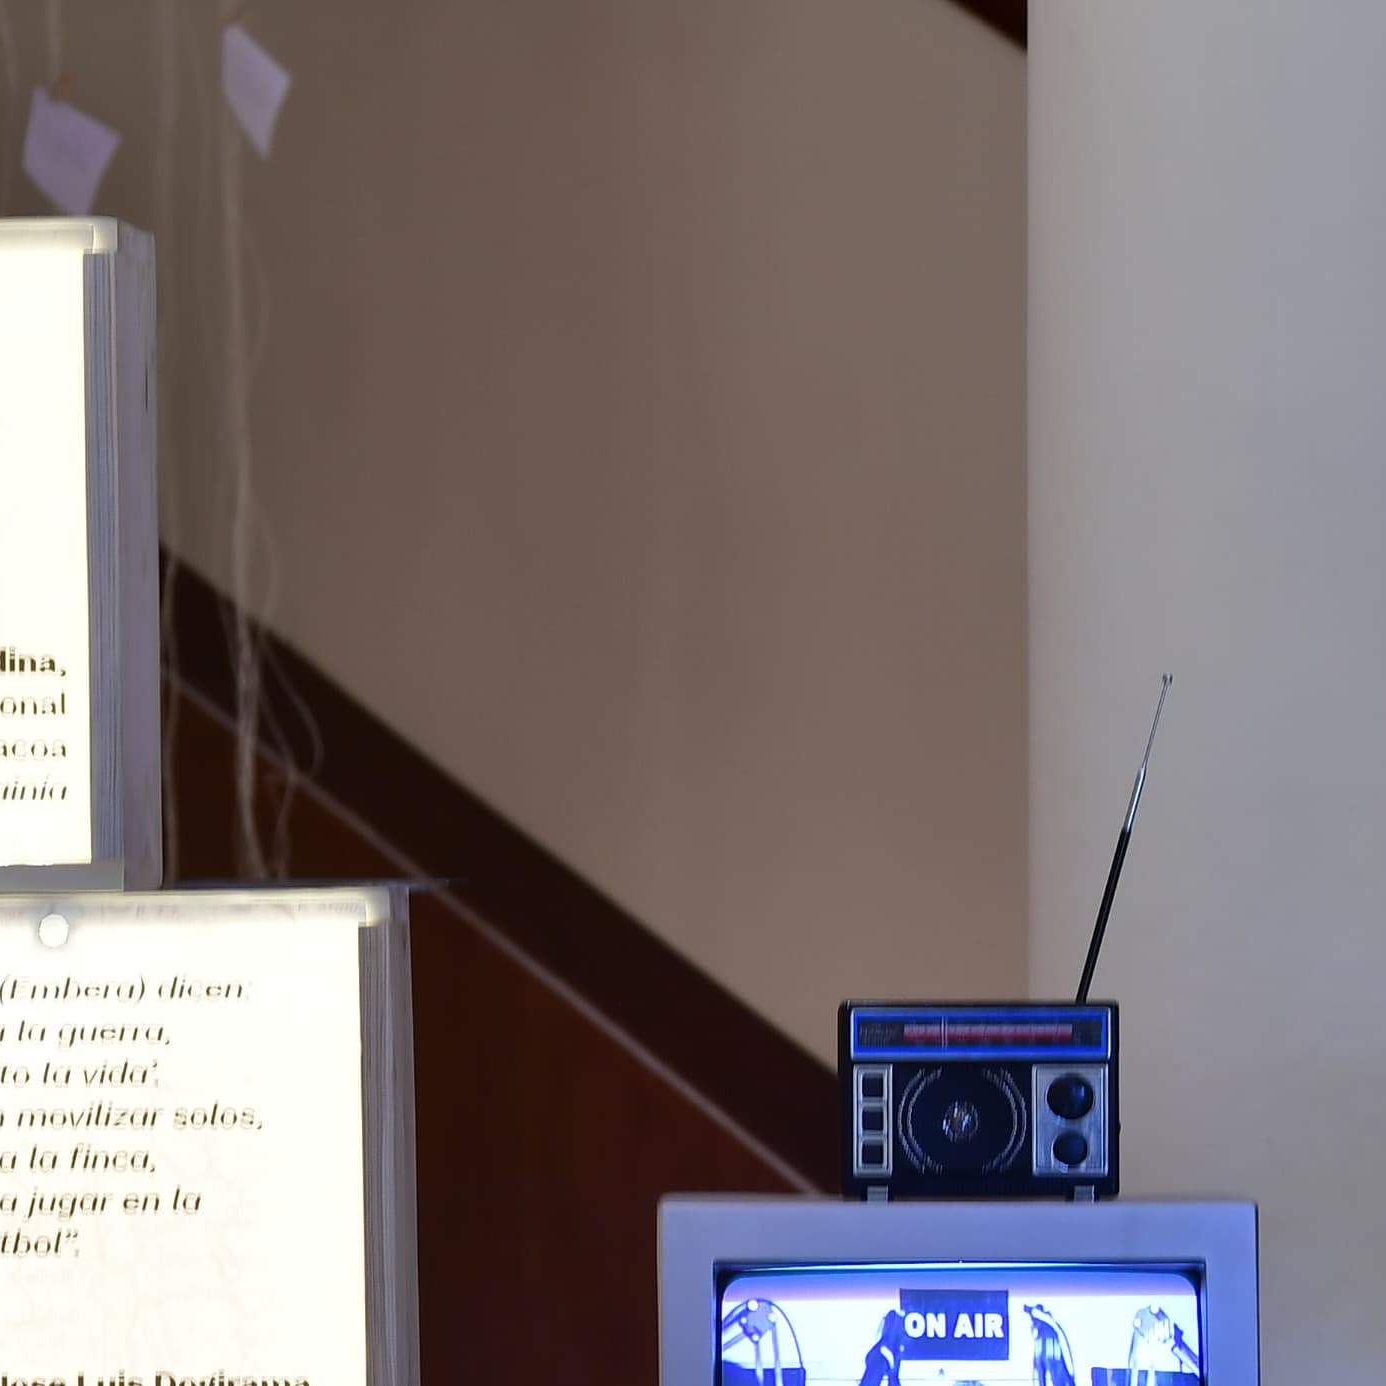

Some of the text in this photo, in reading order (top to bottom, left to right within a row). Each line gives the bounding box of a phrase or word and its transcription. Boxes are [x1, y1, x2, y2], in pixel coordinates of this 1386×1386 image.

[17, 1019, 47, 1043] la
[57, 1023, 171, 1049] guerra,
[42, 1061, 72, 1088] la
[16, 1101, 164, 1131] movilizar
[172, 1100, 264, 1131] solos,
[28, 1143, 59, 1173] la
[69, 1142, 157, 1174] finca,
[23, 1186, 113, 1220] jugar
[122, 1192, 161, 1215] en
[172, 1184, 202, 1216] la
[904, 1312, 1005, 1338] ON AIR
